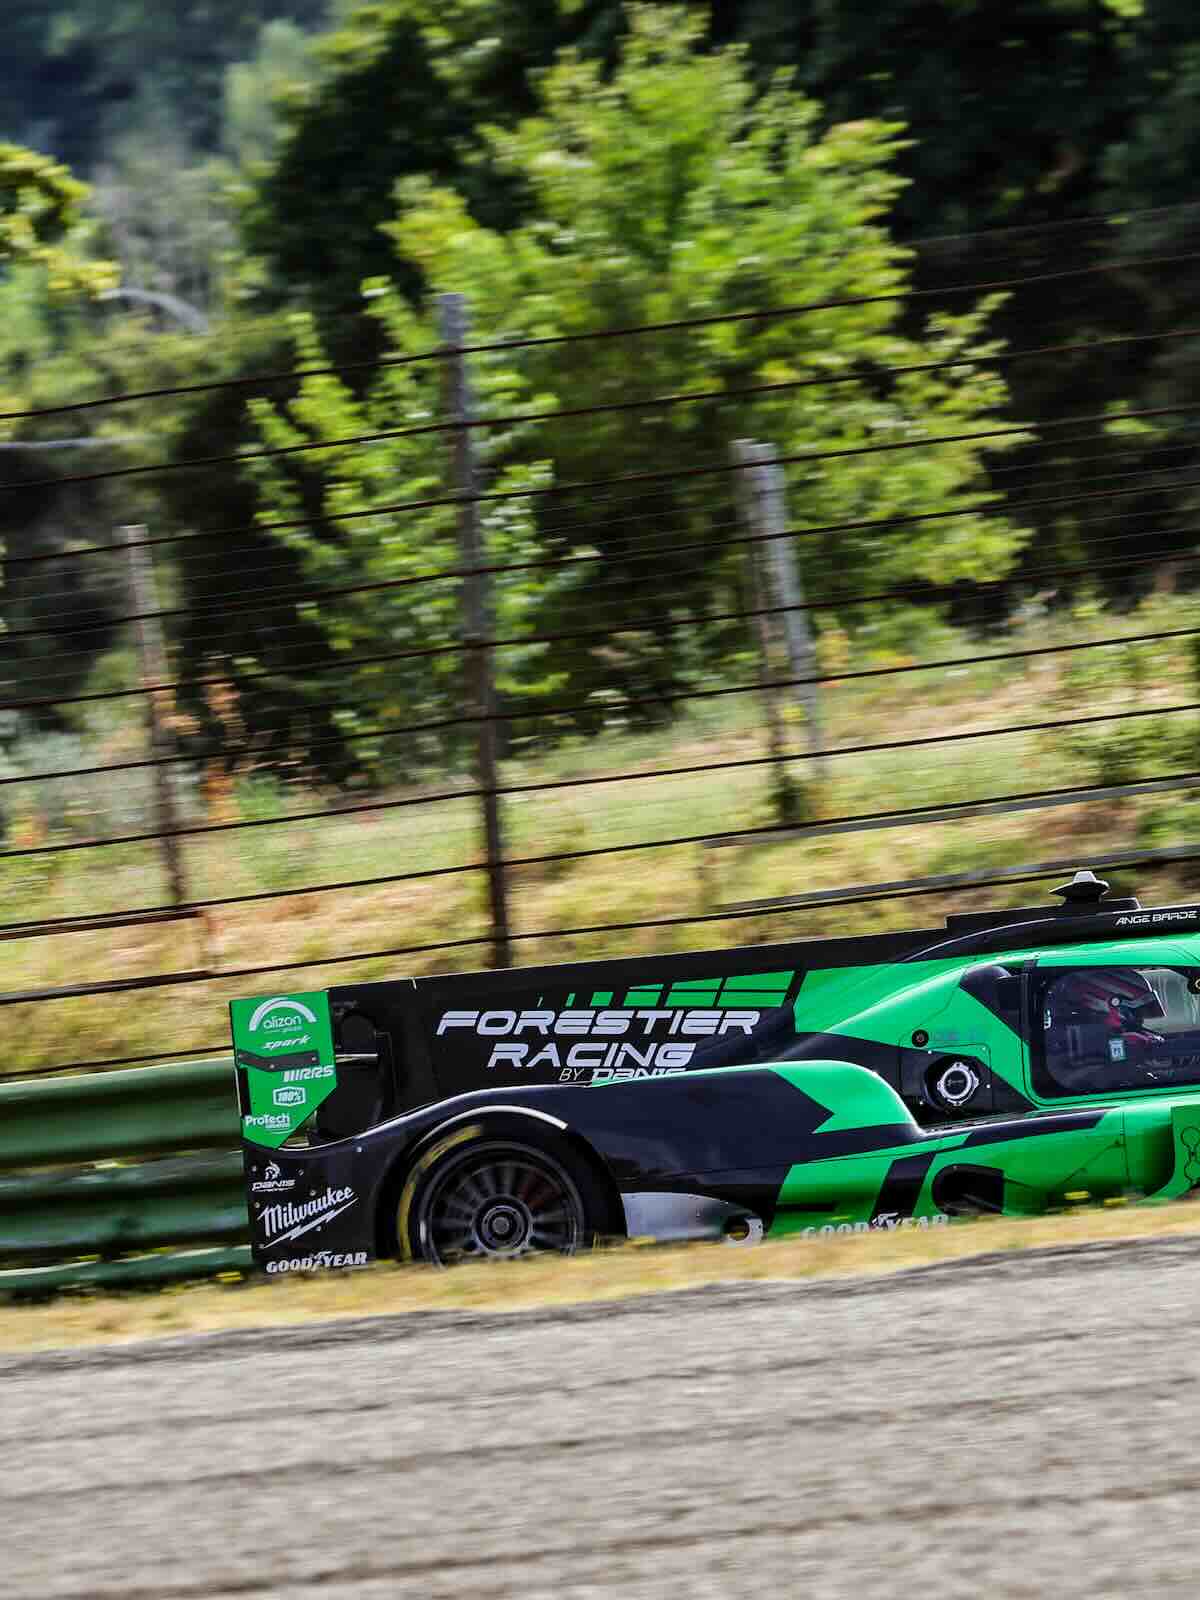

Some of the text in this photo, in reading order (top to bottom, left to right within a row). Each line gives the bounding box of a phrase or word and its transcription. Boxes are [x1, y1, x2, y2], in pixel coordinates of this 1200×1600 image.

[1115, 914, 1151, 926] ANGE
[436, 1010, 761, 1036] FORESTIER
[487, 1042, 697, 1068] RACING
[558, 1068, 586, 1081] BY
[244, 1113, 291, 1127] ProTech
[257, 1186, 356, 1239] Milwaukee
[265, 1250, 368, 1273] GOODYEAR
